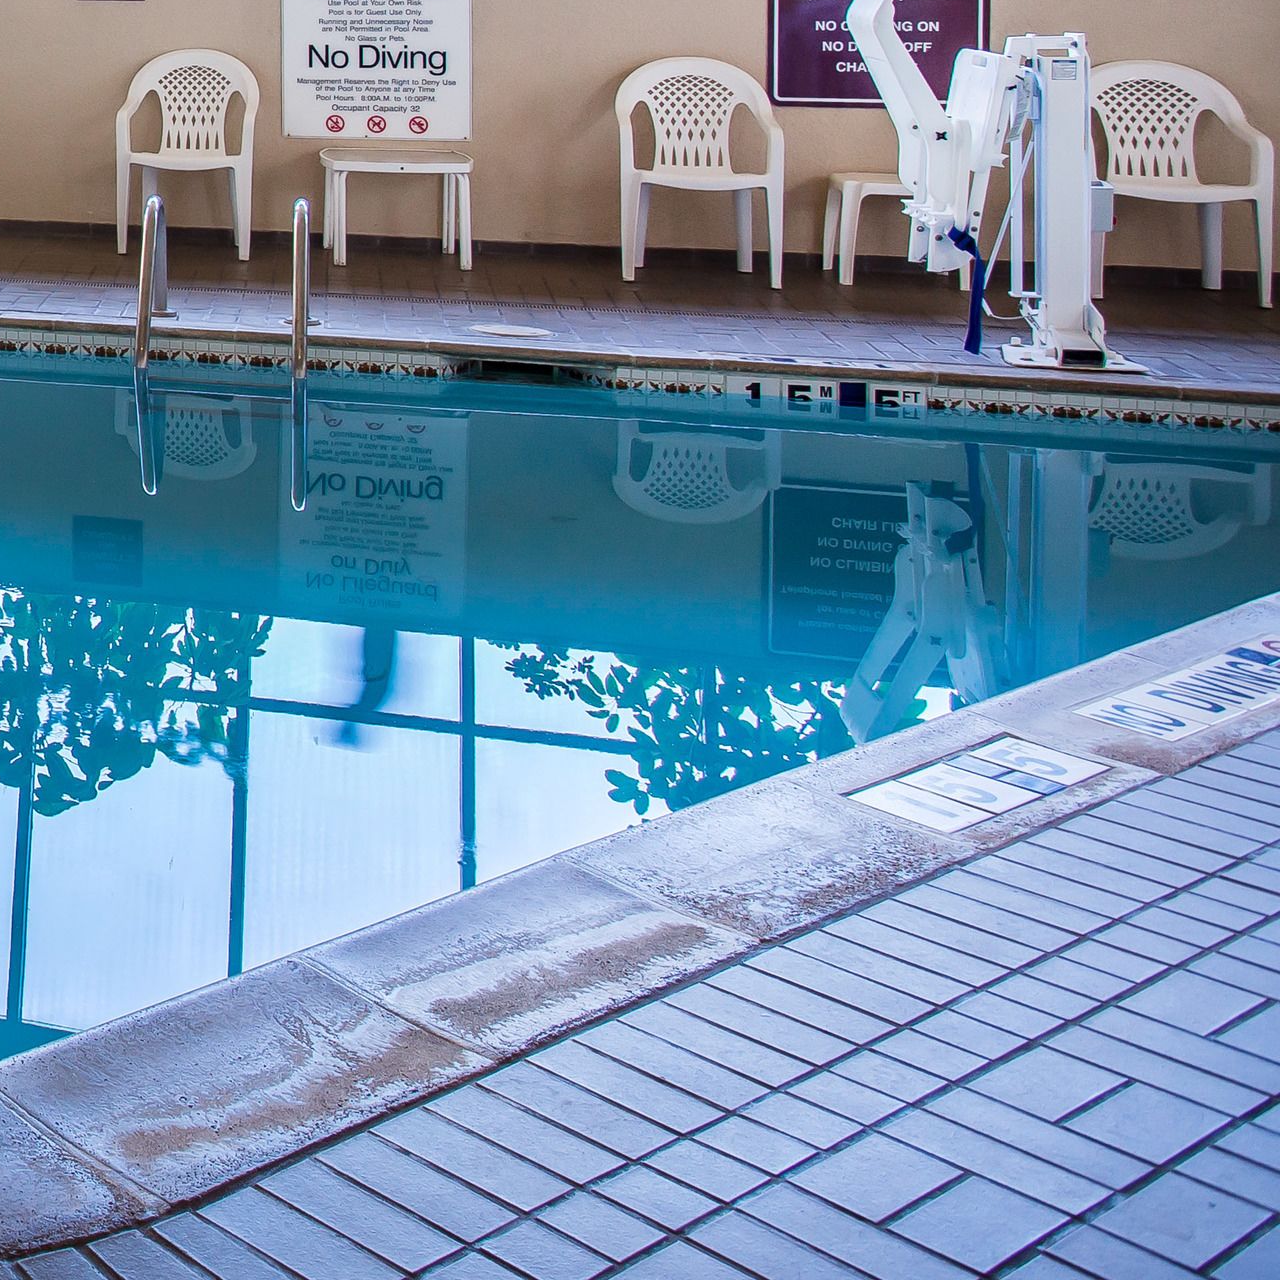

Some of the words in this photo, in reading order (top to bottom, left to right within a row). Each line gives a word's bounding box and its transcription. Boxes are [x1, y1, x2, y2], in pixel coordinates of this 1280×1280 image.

[815, 21, 837, 31] NO
[917, 21, 940, 31] ON
[822, 41, 843, 52] NO
[904, 42, 933, 53] OFF
[308, 45, 349, 68] No
[359, 45, 446, 76] Diving
[836, 62, 869, 72] CHA
[332, 104, 370, 112] Occupant
[372, 105, 407, 113] Capacity
[410, 104, 420, 112] 32
[820, 386, 832, 398] M
[902, 391, 920, 404] FT
[1090, 704, 1186, 736] NO
